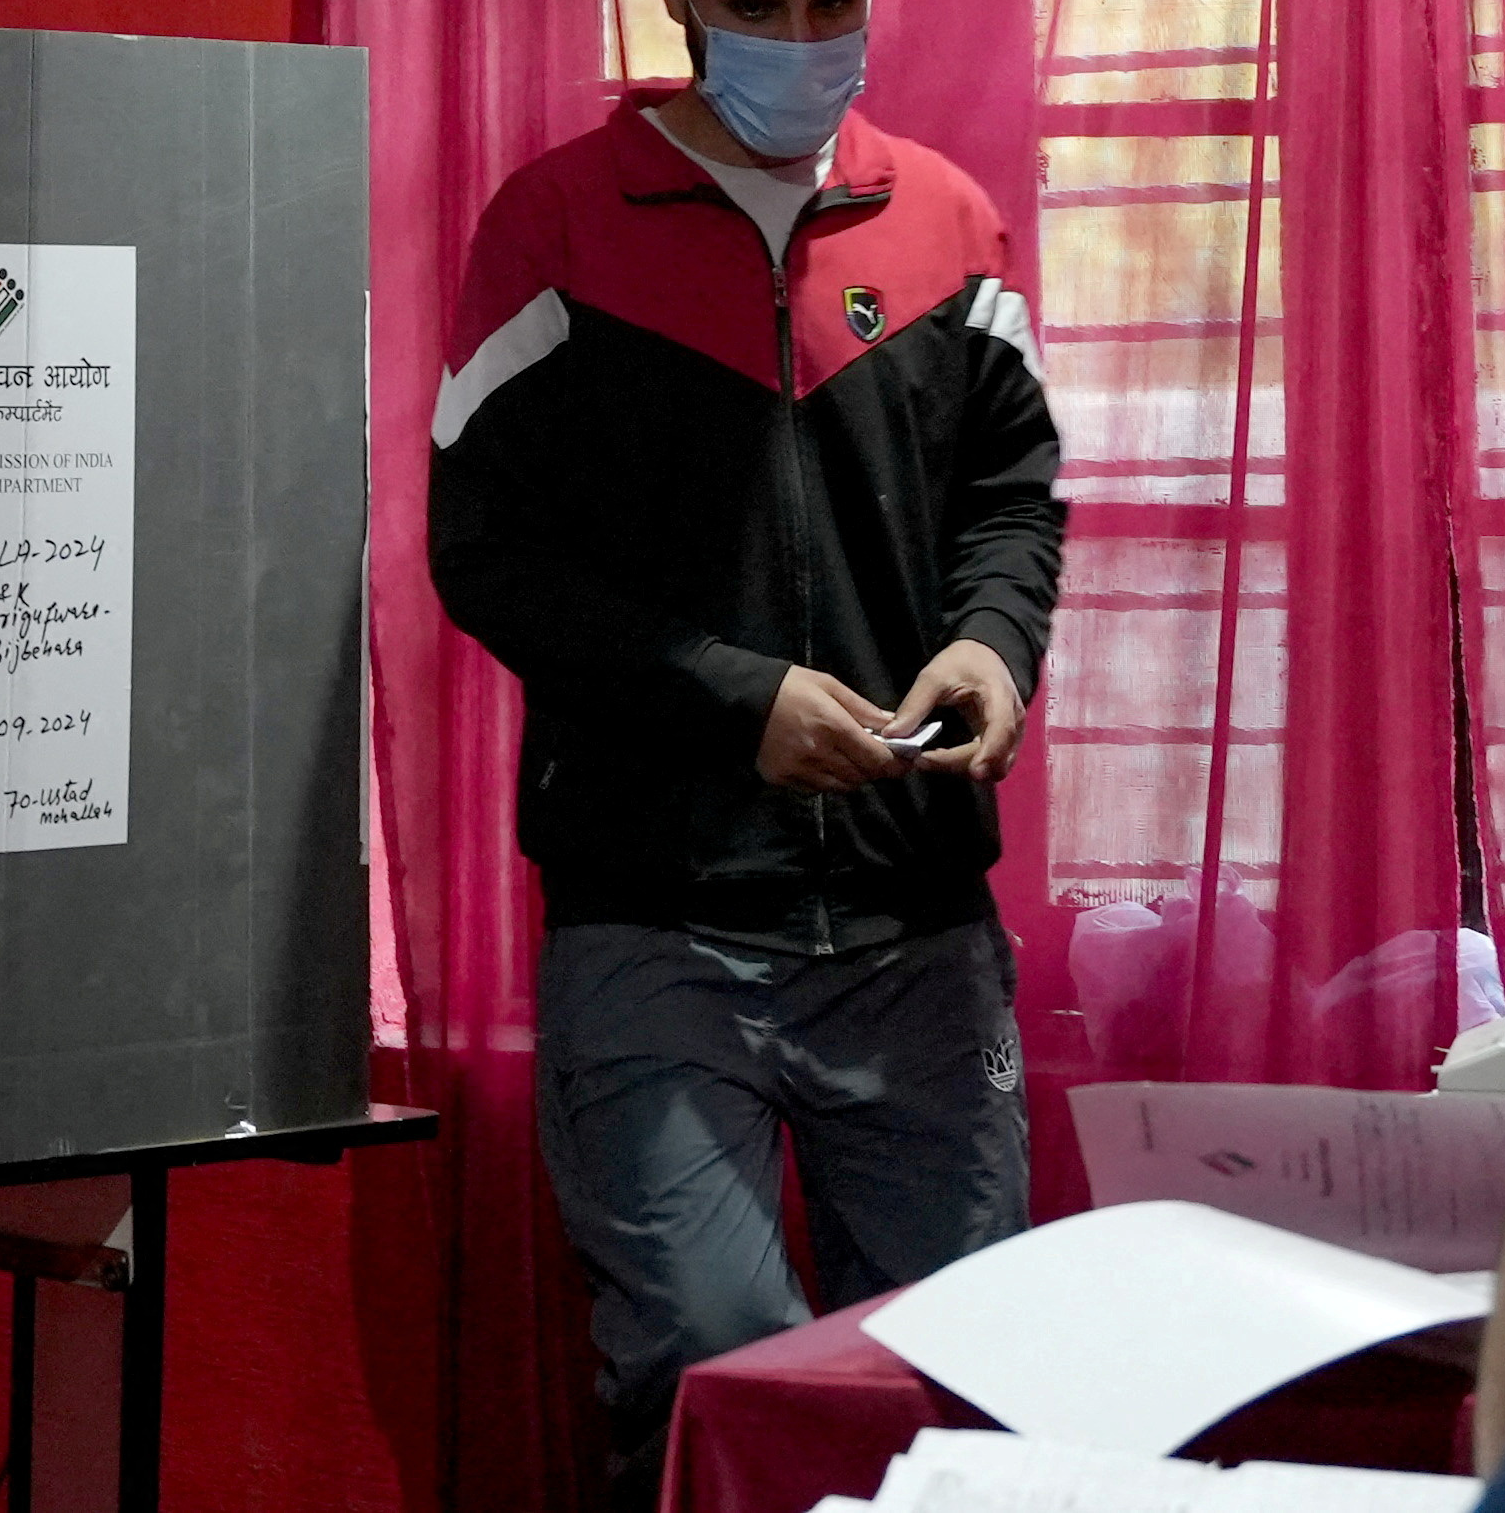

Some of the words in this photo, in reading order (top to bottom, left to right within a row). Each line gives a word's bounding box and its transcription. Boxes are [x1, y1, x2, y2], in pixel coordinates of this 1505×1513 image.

[43, 358, 110, 389] आयोग
[53, 453, 72, 469] OF
[75, 452, 114, 468] INDIA
